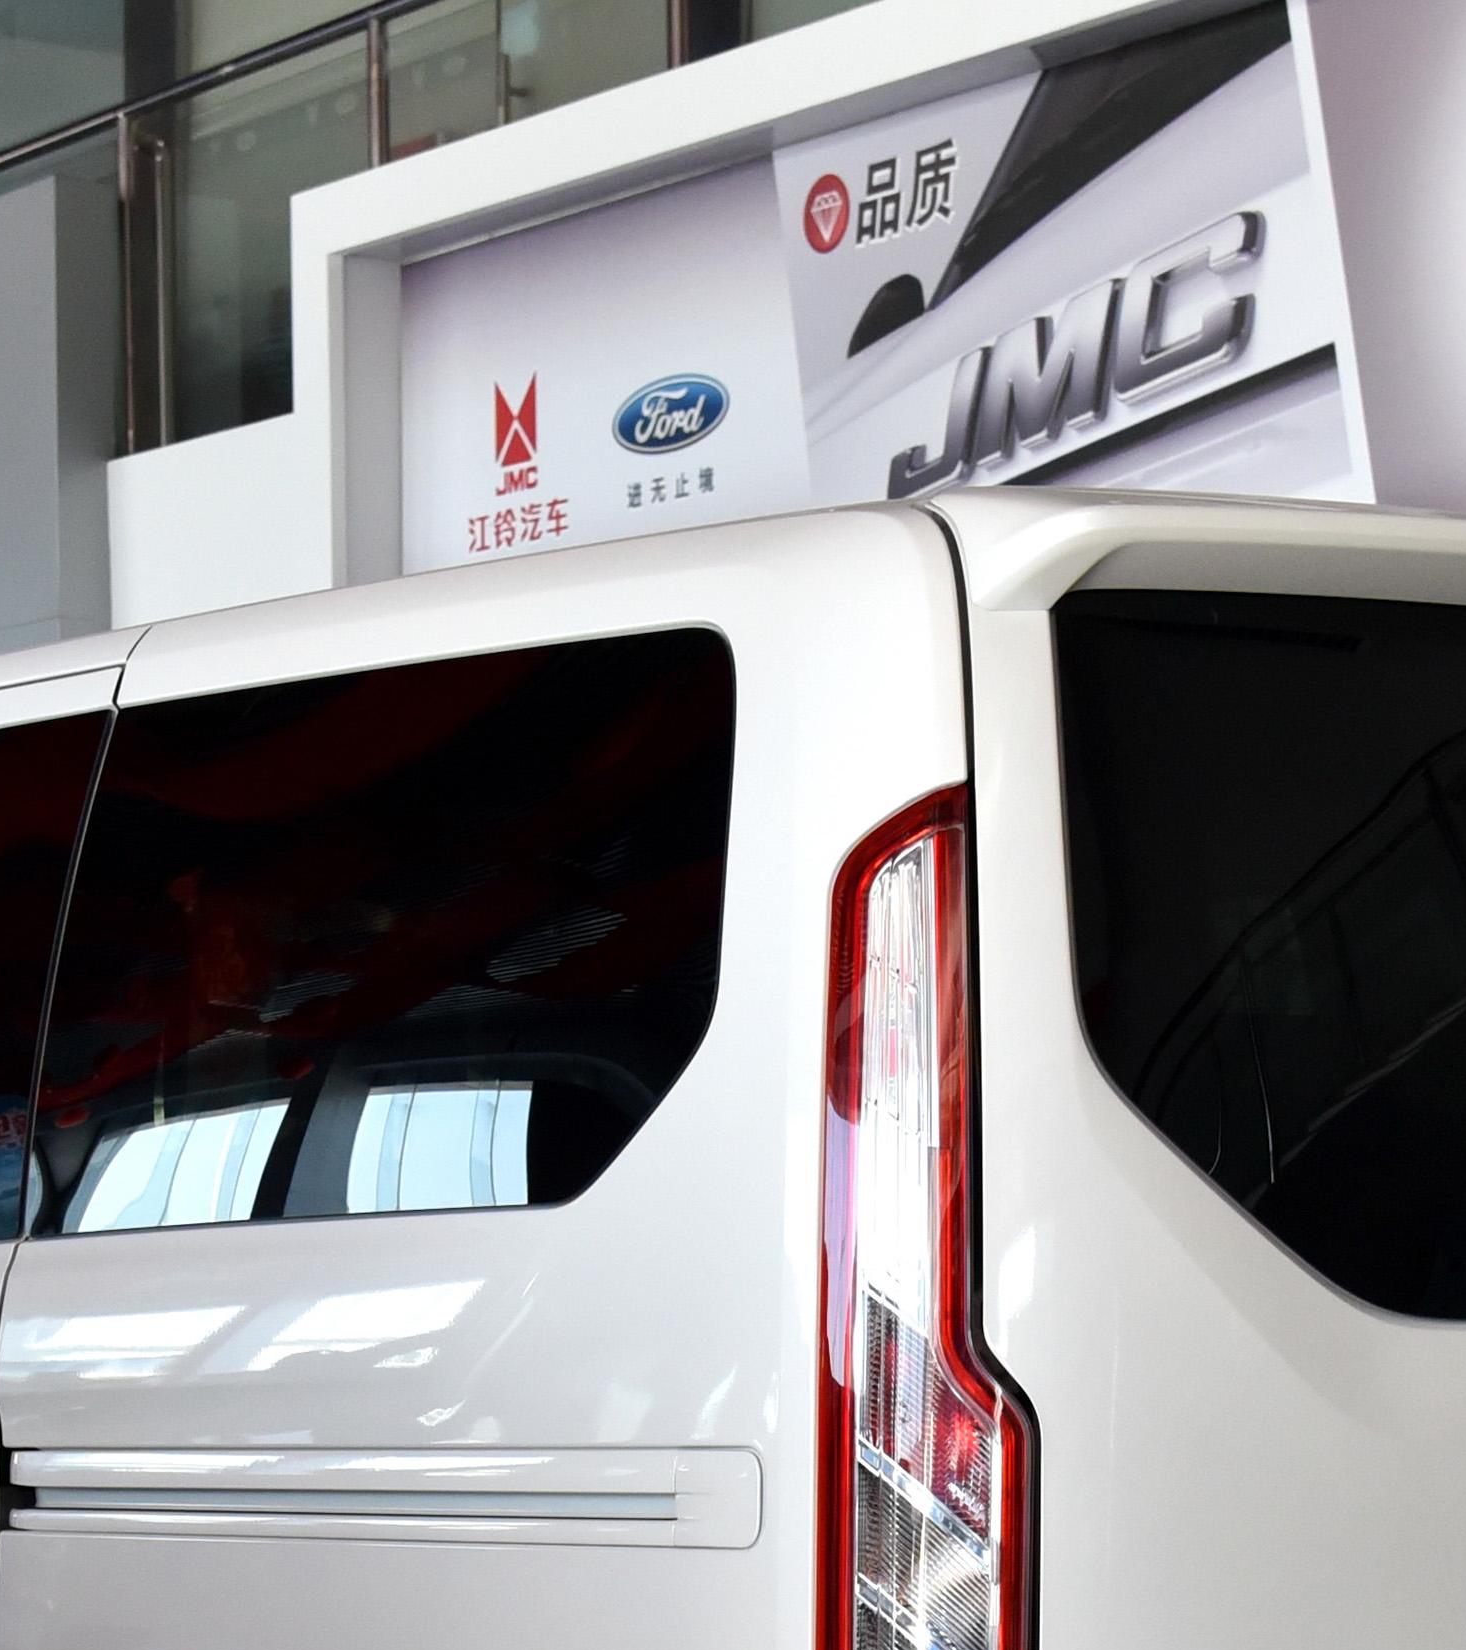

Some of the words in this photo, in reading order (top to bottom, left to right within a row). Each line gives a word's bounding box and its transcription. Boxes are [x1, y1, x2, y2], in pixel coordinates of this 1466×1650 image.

[855, 137, 959, 246] 品质
[888, 209, 1266, 500] JMC
[634, 386, 705, 444] Ford
[495, 466, 539, 497] JMC
[627, 466, 715, 509] 进无止境
[468, 498, 570, 553] 江铃汽车
